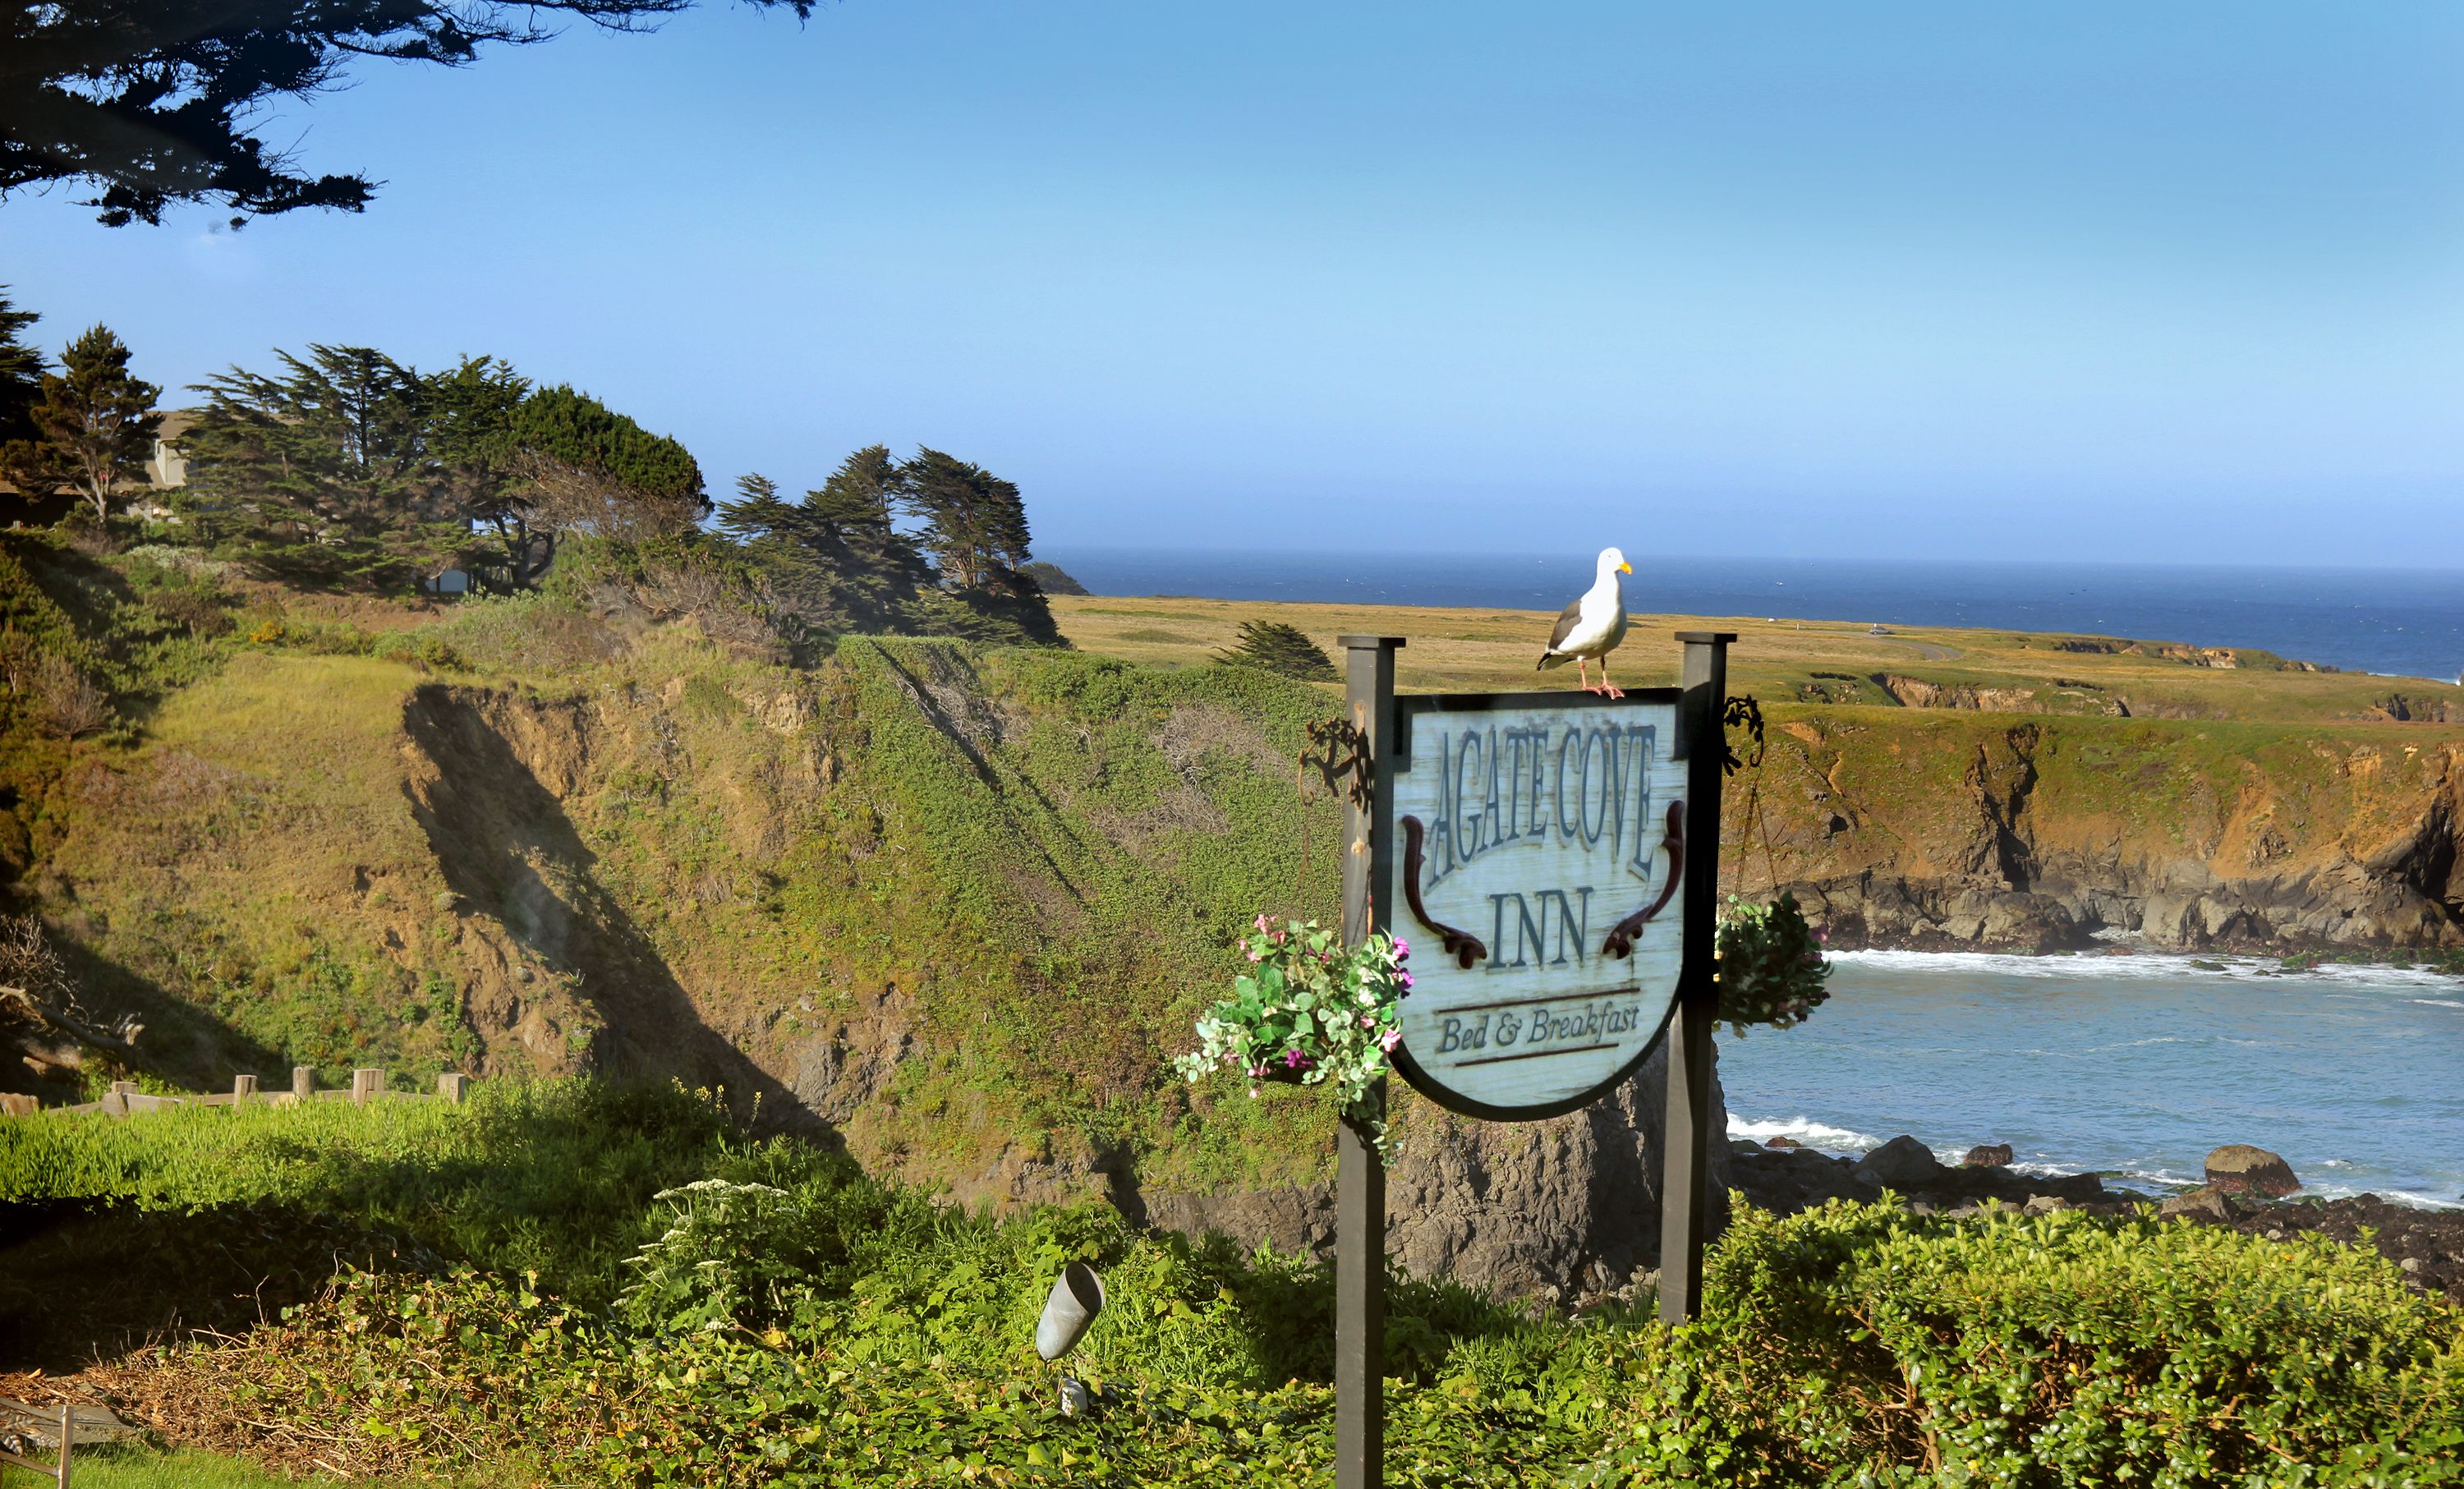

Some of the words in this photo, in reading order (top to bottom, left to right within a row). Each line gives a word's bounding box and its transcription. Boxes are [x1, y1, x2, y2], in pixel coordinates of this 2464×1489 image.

[1427, 728, 1548, 888] AGATE
[1558, 724, 1656, 881] COVE
[1489, 887, 1593, 969] INN
[1440, 1014, 1488, 1054] Bed
[1496, 1012, 1523, 1046] &
[1528, 1002, 1640, 1045] Breakfast
